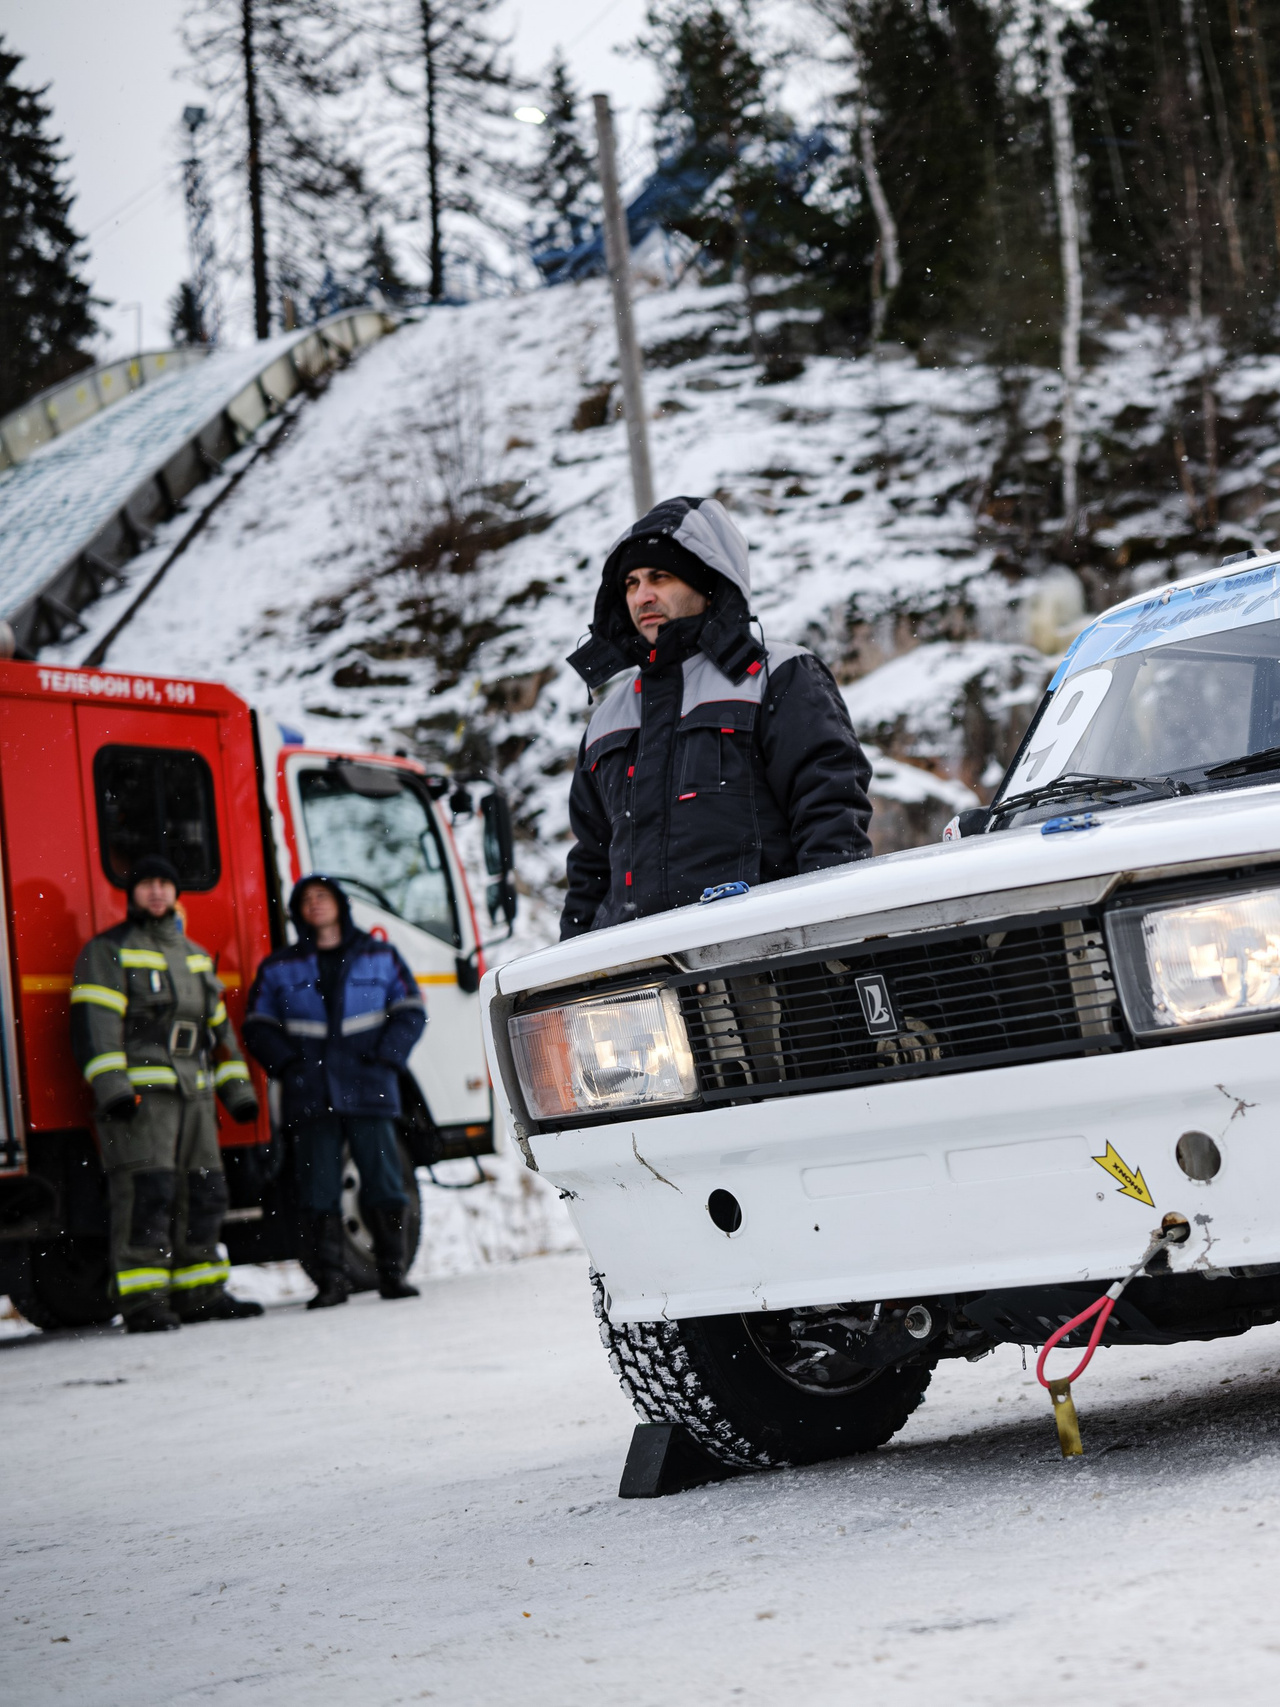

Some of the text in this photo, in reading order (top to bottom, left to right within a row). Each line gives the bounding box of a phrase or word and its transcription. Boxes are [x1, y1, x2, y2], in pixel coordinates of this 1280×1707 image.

[38, 669, 131, 698] ТЕЛЕФОН
[165, 682, 196, 704] 101
[999, 669, 1113, 806] 9
[1112, 1162, 1144, 1196] SHONX
